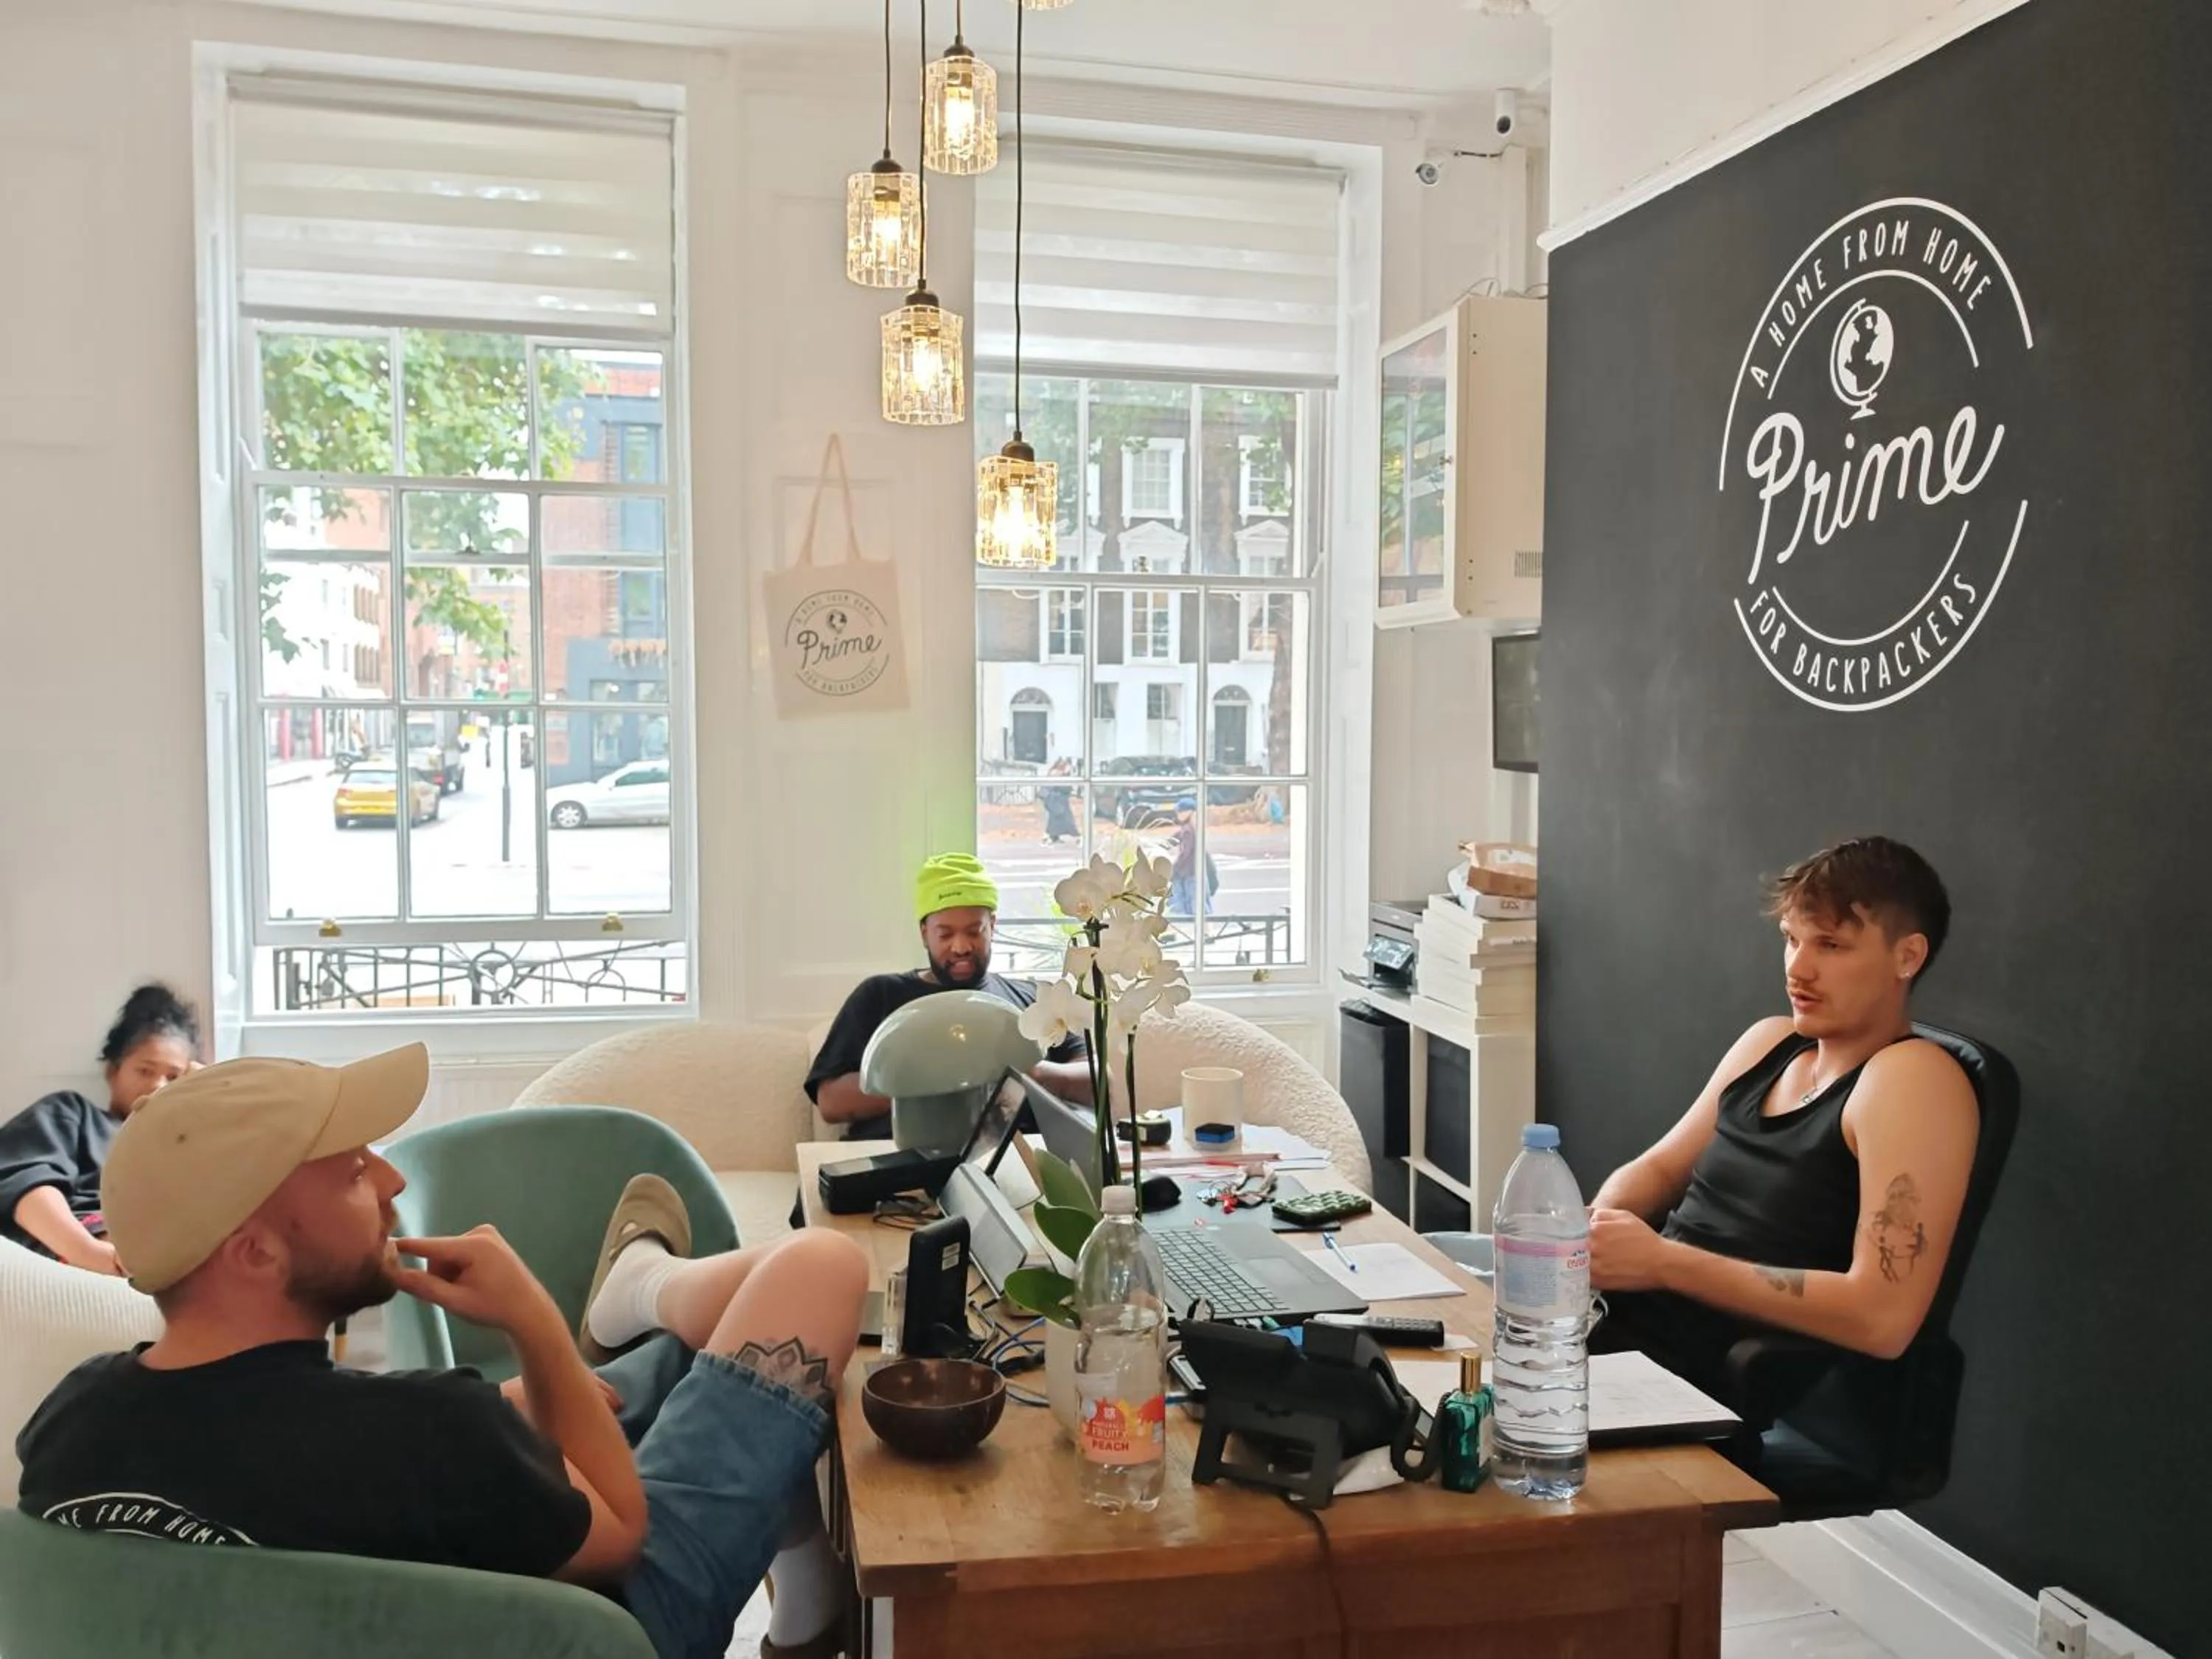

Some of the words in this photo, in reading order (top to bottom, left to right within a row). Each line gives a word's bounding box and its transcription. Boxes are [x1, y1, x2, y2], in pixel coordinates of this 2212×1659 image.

[1750, 365, 1769, 389] A
[1767, 258, 1826, 347] HOME
[1842, 220, 1910, 270] FROM
[1921, 226, 1992, 310] HOME
[1745, 406, 2006, 585] Prime
[797, 630, 883, 670] Prime
[1750, 589, 1787, 655] FOR
[1792, 572, 1977, 695] BACKPACKERS
[1092, 1439, 1130, 1452] PEACH
[94, 1503, 162, 1524] FROM
